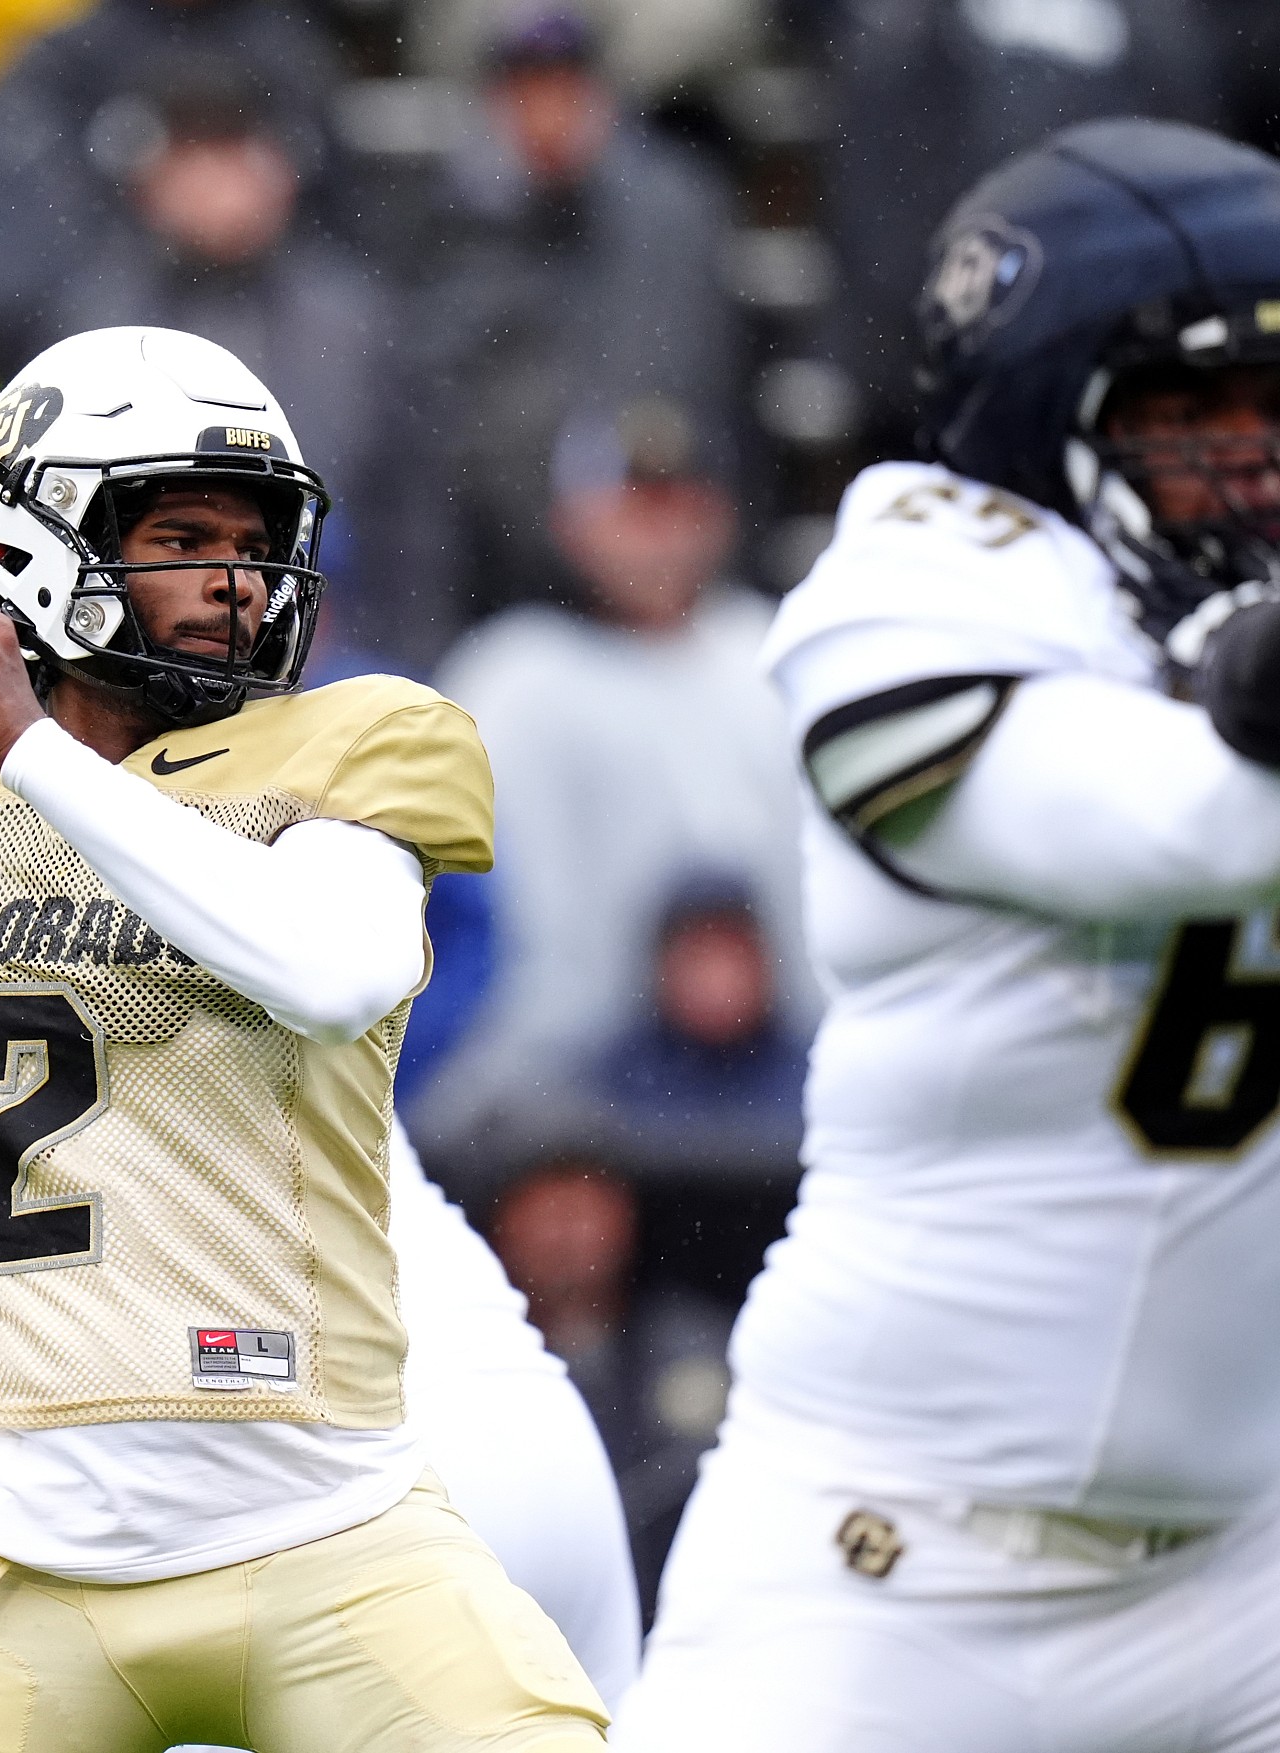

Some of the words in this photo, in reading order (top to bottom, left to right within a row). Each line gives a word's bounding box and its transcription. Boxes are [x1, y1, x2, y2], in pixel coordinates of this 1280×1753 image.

[225, 427, 271, 451] BUFFS
[261, 573, 298, 623] Riddell
[257, 1336, 269, 1352] L
